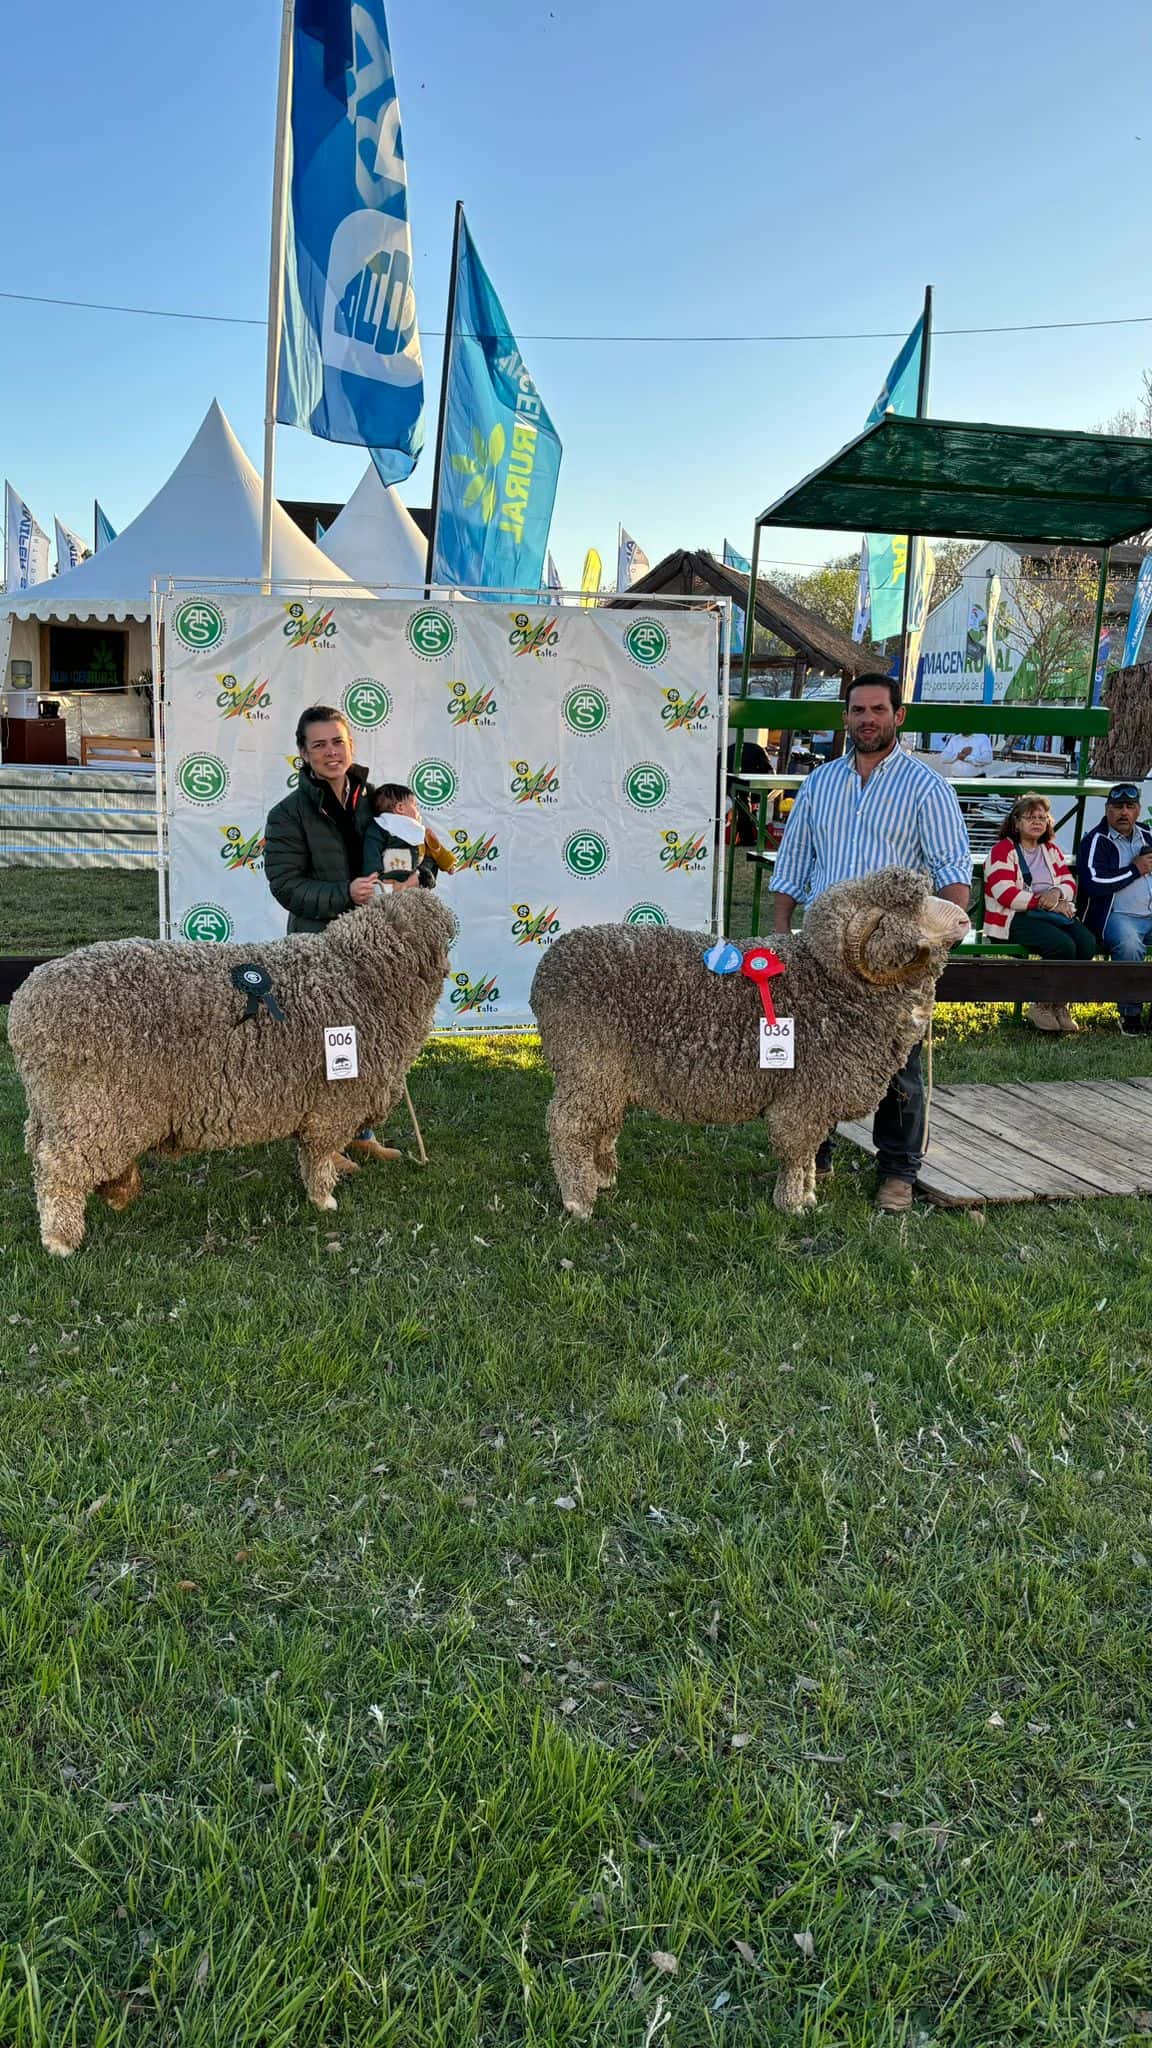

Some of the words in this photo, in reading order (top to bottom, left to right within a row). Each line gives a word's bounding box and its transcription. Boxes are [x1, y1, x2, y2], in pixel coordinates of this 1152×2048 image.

[283, 614, 339, 643] expo
[509, 627, 560, 654] expo
[217, 688, 273, 716] expo
[447, 696, 499, 723] expo
[661, 701, 709, 727] expo
[511, 775, 560, 799] expo
[221, 839, 265, 866] exp
[659, 843, 709, 868] expo
[511, 917, 561, 943] expo
[450, 983, 500, 1009] expo
[328, 1033, 353, 1047] 006
[764, 1024, 790, 1037] 036
